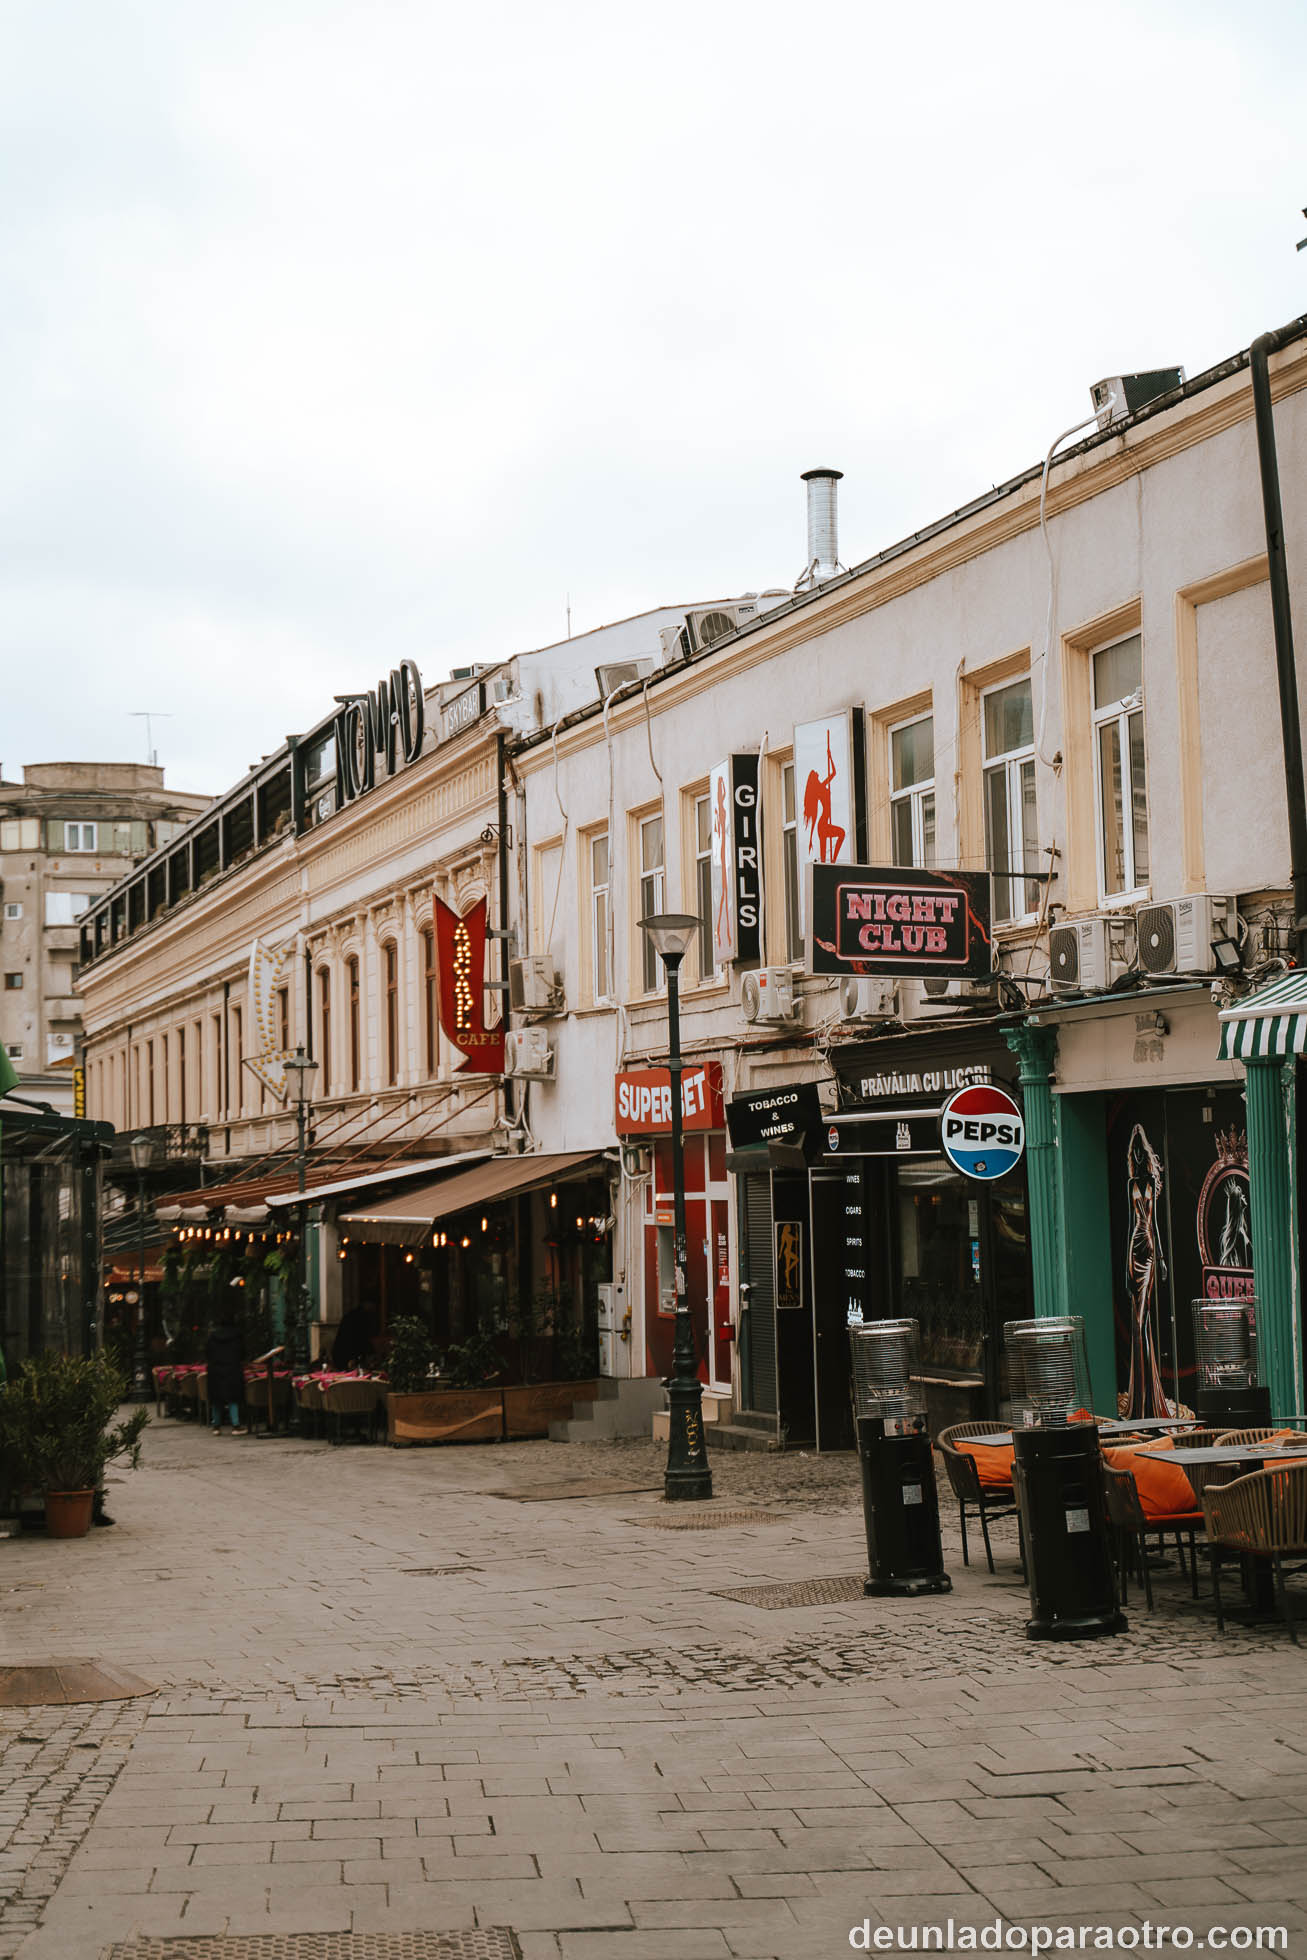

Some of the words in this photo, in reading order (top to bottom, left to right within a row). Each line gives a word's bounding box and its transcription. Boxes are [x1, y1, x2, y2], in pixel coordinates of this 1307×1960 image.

[334, 659, 424, 811] NOMAD
[734, 784, 757, 928] GIRLS
[846, 893, 959, 923] NIGHT
[858, 924, 948, 952] CLUB
[456, 1033, 501, 1046] CAFE
[860, 1071, 920, 1098] PRĂVĂLIA
[923, 1071, 941, 1093] CU
[748, 1093, 799, 1112] TOBACCO
[760, 1122, 795, 1138] WINES
[771, 1112, 780, 1121] &
[947, 1119, 1021, 1146] PEPSI
[845, 1206, 862, 1215] CIGARS
